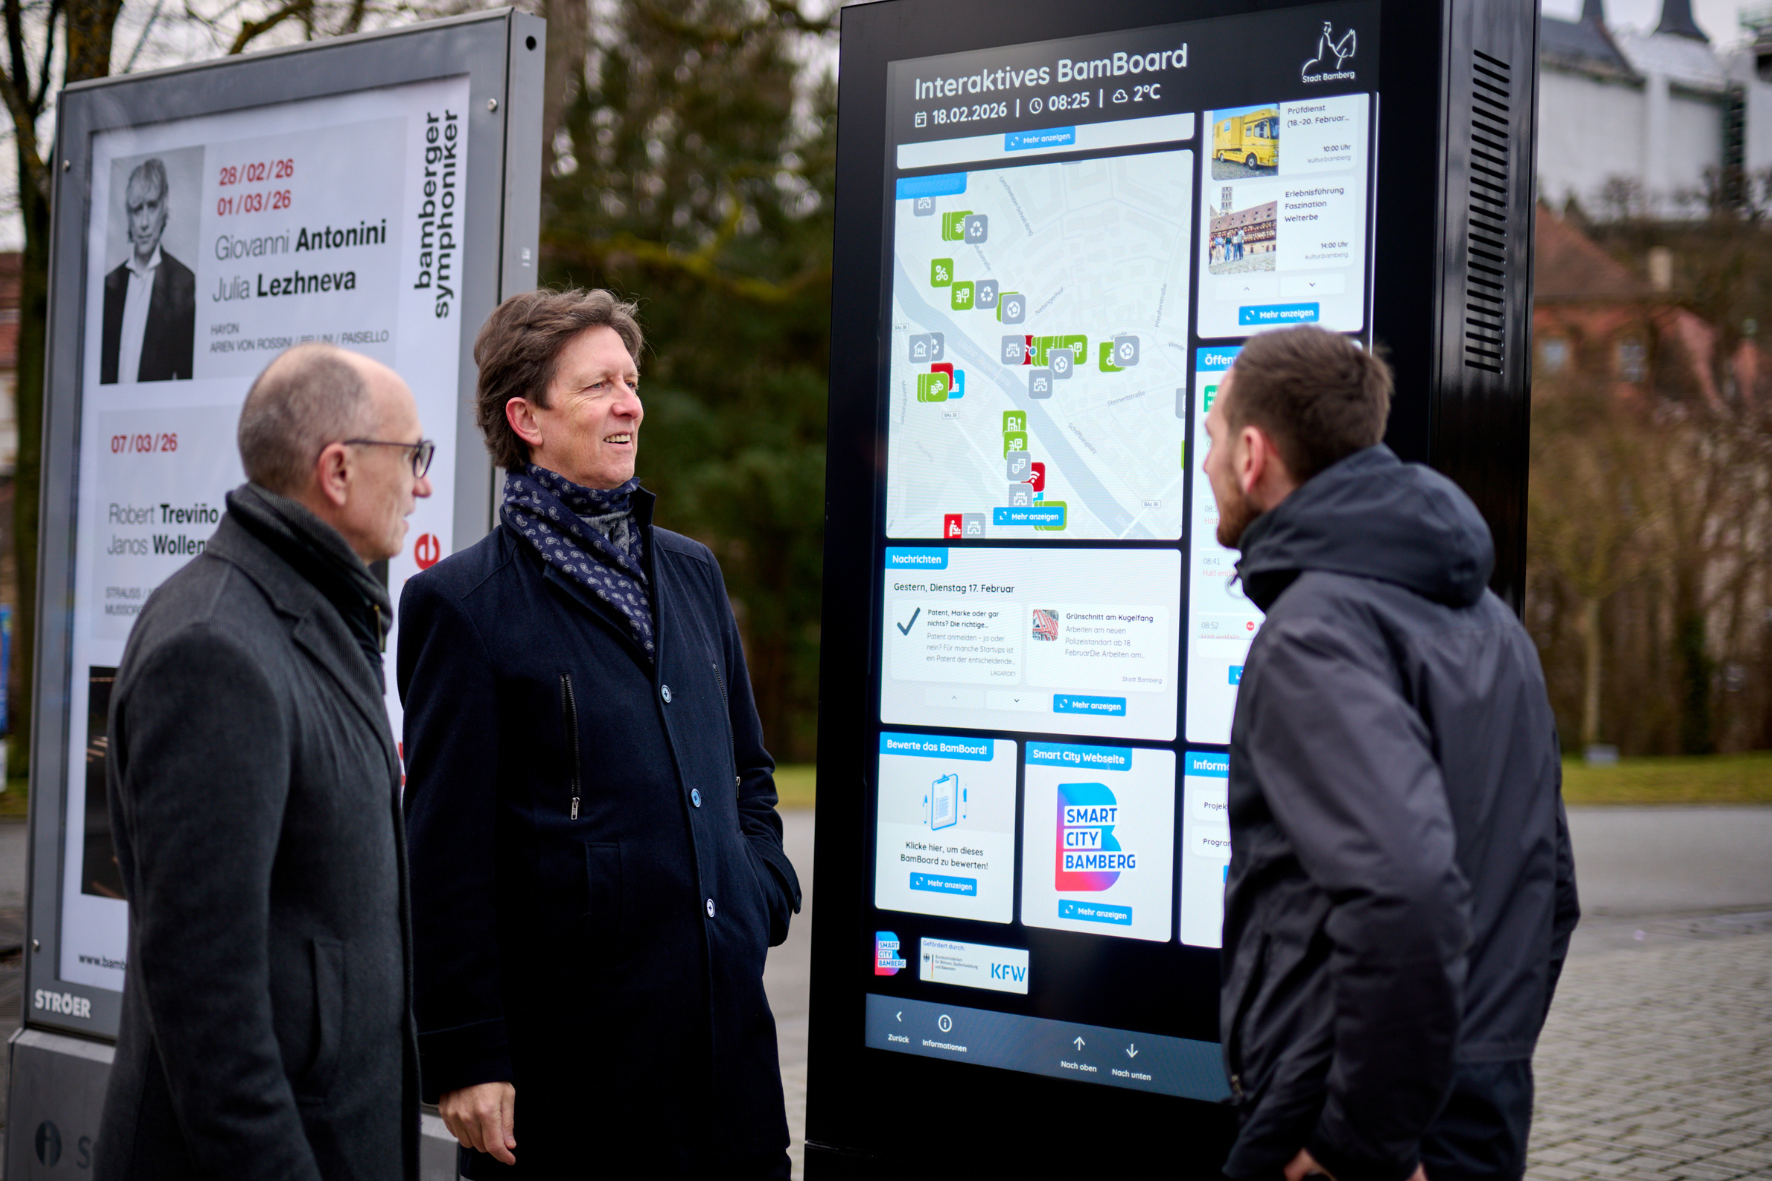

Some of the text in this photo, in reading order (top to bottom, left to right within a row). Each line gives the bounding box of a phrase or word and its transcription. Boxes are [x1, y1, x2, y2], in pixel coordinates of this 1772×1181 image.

[914, 42, 1188, 100] Interaktives BamBoard
[1302, 71, 1356, 83] Stadt Bamberg
[932, 101, 1007, 125] 18.02.2026
[1048, 92, 1090, 112] 08:25
[1287, 104, 1326, 115] Prüfdienst
[1023, 132, 1071, 144] Mehr anzeigen
[219, 158, 294, 186] 28/02/26
[1285, 187, 1344, 198] Erlebnisführung
[217, 190, 291, 216] 01/03/26
[414, 112, 442, 289] bamberger
[1285, 200, 1327, 210] Faszination
[435, 110, 458, 319] symphoniker
[1284, 213, 1318, 222] Welterbe
[215, 218, 386, 260] Giovanni Antonini
[213, 271, 356, 302] Julia Lezhneva
[1259, 309, 1314, 319] Mehr anzeigen
[211, 323, 239, 335] HAYDN
[210, 340, 234, 353] ARIEN
[237, 339, 255, 351] VON
[258, 337, 292, 350] ROSSINI
[342, 329, 389, 344] PAISIELLO
[111, 433, 178, 454] 07/03/26
[109, 503, 218, 525] Robert Treviño
[1029, 513, 1059, 522] anzeigen
[107, 534, 206, 556] Janos Wollen
[892, 555, 942, 564] Nachrichten
[105, 586, 141, 599] STRAUSS
[893, 583, 1015, 595] Gestern, Dienstag 17. Februar
[928, 609, 950, 618] Patent,
[972, 610, 987, 618] oder
[988, 611, 999, 619] gar
[1066, 613, 1104, 621] Grünschnitt
[1118, 614, 1154, 623] Kugelfang
[927, 620, 949, 628] nichts?
[950, 620, 960, 628] Die
[1065, 626, 1092, 634] Arbeiten
[1201, 621, 1219, 630] 08:52
[927, 633, 946, 641] Patent
[947, 634, 977, 642] anmelden
[983, 635, 989, 643] ja
[1065, 637, 1112, 647] Polizeistandort
[1113, 639, 1122, 647] ab
[943, 644, 953, 652] Für
[980, 645, 1005, 654] Startups
[1006, 646, 1014, 654] ist
[1102, 650, 1129, 658] Arbeiten
[936, 655, 956, 663] Patent
[1137, 677, 1162, 685] Bamberg
[1072, 701, 1122, 712] Mehr anzeigen
[886, 739, 988, 755] Bewerte das BamBoard!
[1033, 749, 1125, 764] Smart City Webseite
[1204, 801, 1228, 811] Projek
[1066, 808, 1118, 823] SMART
[1066, 831, 1099, 846] CITY
[905, 842, 983, 856] Klicke hier, um dieses
[900, 854, 989, 870] BamBoard zu bewerten!
[1065, 854, 1136, 869] BAMBERG
[927, 879, 973, 891] Mehr anzeigen
[1078, 907, 1127, 920] Mehr anzeigen
[923, 940, 965, 951] Gefördert durch:
[878, 951, 892, 959] CITY
[78, 954, 126, 971] www.bamb
[34, 988, 91, 1019] STRÖER
[888, 1034, 910, 1044] Zurück
[922, 1039, 967, 1053] Informationen
[1060, 1060, 1098, 1073] Nach oben
[1111, 1068, 1152, 1081] Nach unten
